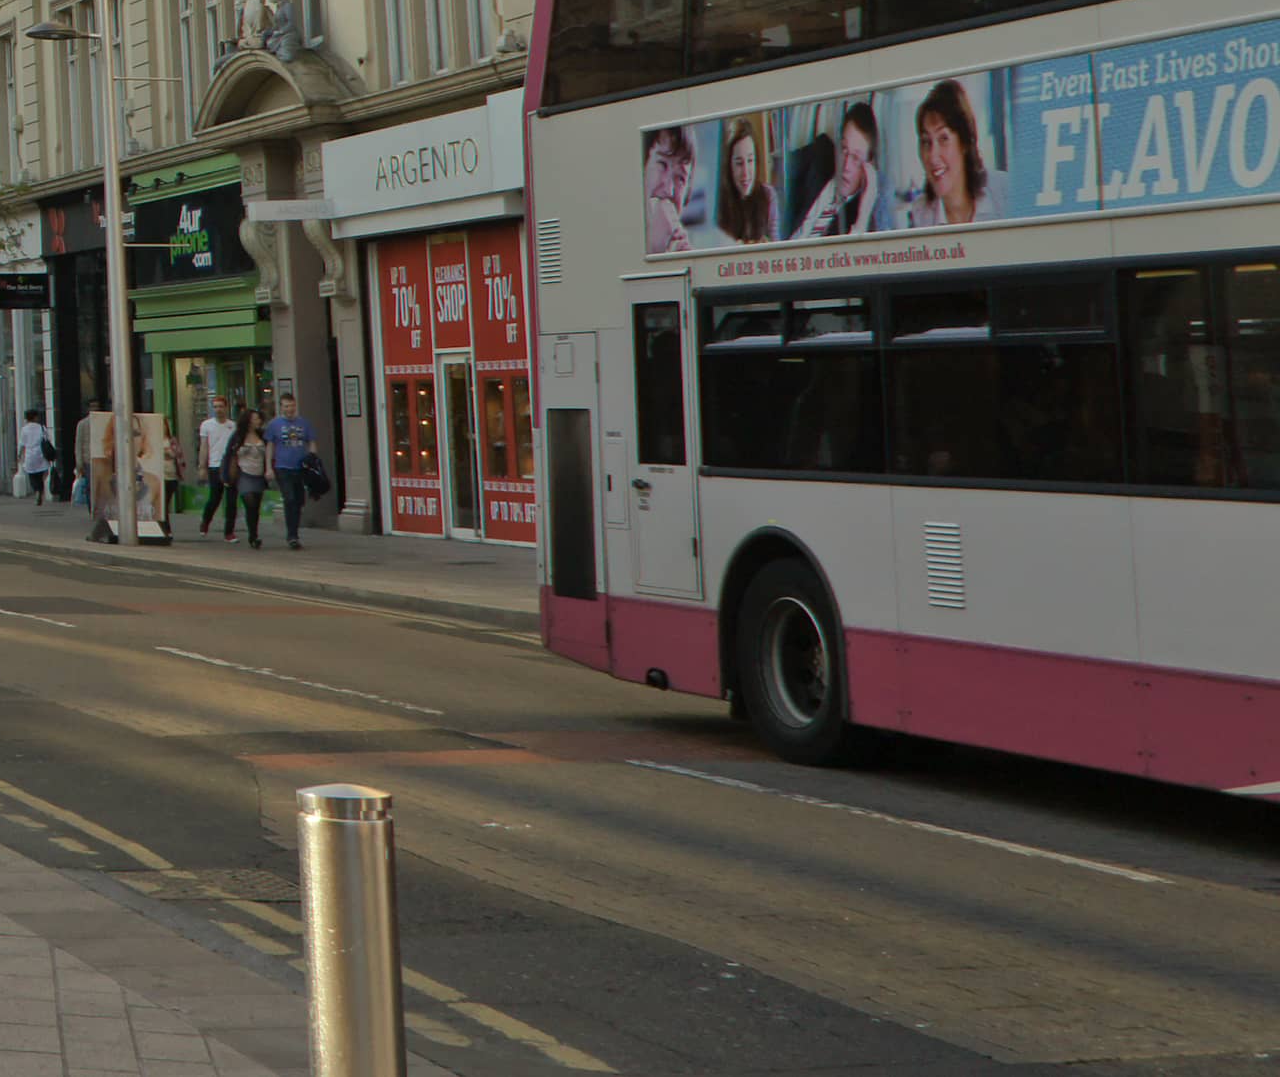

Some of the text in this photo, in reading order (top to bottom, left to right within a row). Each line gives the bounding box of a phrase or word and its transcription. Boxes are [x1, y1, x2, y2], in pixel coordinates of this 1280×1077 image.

[1040, 71, 1093, 101] Even
[1099, 57, 1150, 94] Fast
[1155, 50, 1217, 85] Lives
[375, 138, 479, 192] ARGENTO
[170, 227, 210, 266] phone
[718, 261, 735, 277] Call
[771, 258, 784, 273] 66
[785, 257, 798, 273] 66
[800, 256, 812, 271] 30
[814, 258, 826, 270] or
[827, 251, 851, 268] click
[853, 242, 966, 266] www.translink.co.uk
[391, 283, 421, 328] 70%
[435, 284, 466, 323] SHOP
[484, 273, 517, 321] 70%
